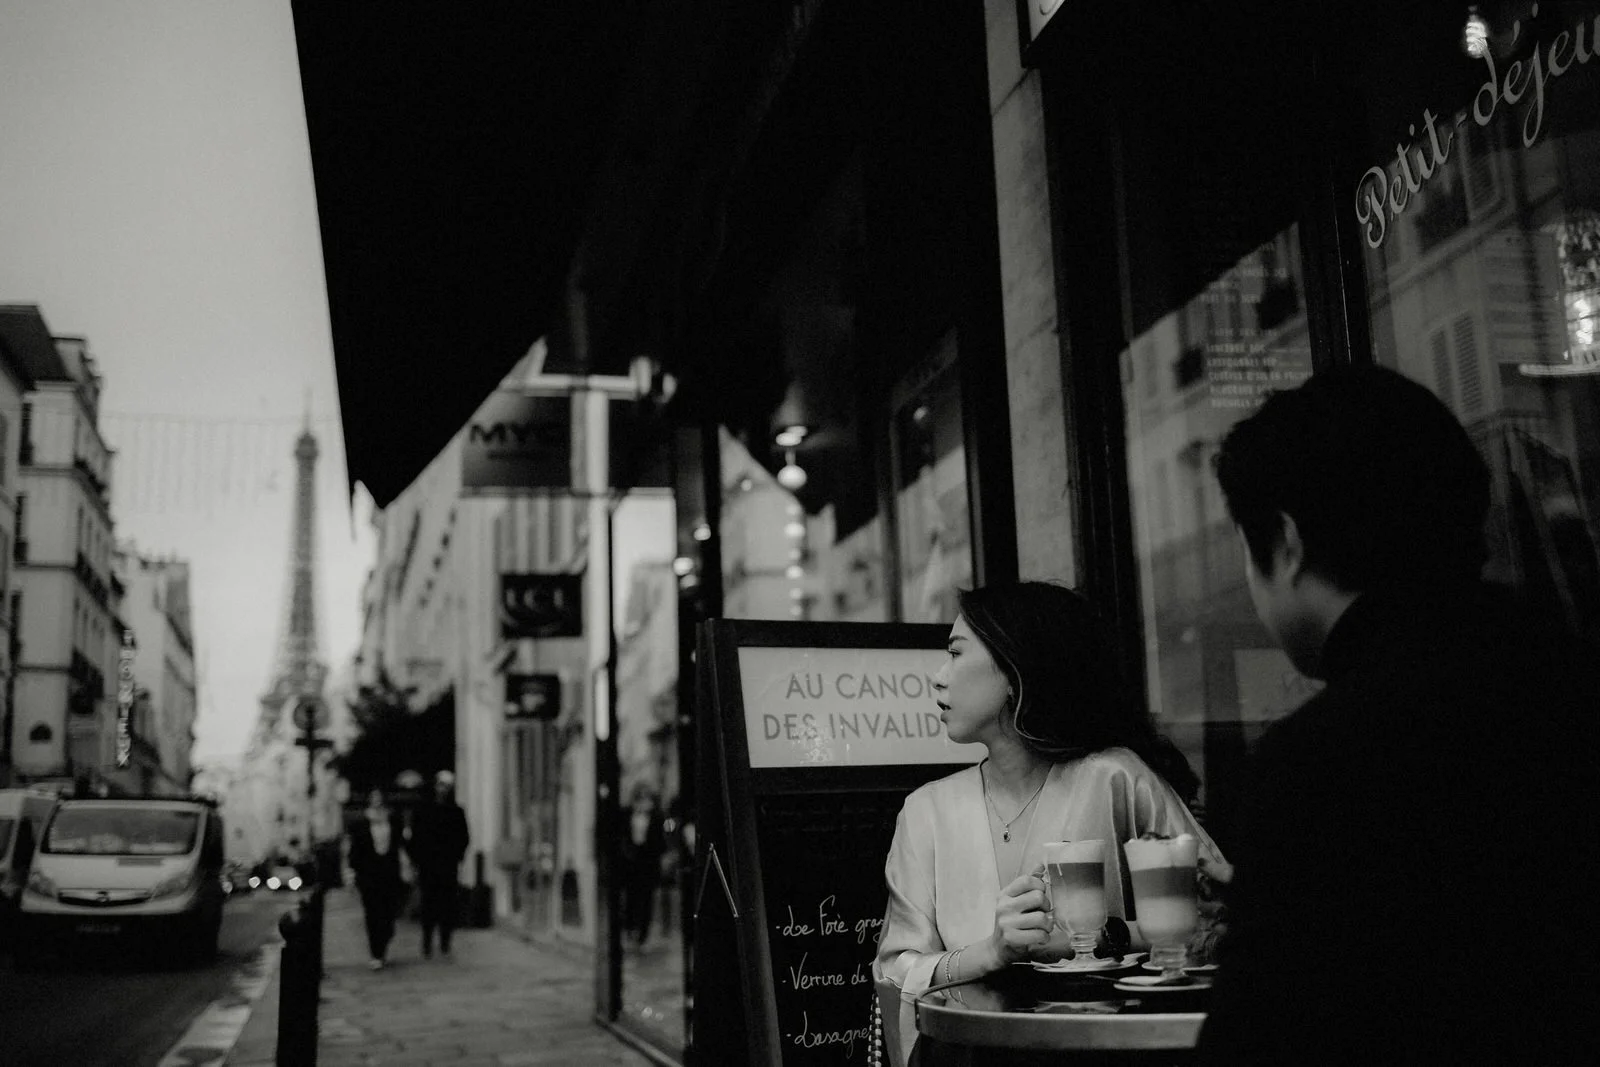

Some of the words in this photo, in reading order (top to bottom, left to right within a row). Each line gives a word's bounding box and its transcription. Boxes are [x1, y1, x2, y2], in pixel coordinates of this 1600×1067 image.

[786, 673, 824, 699] AU
[763, 713, 818, 740] DES
[829, 712, 941, 738] INVALID
[782, 905, 815, 937] Le
[819, 894, 849, 936] Foie
[790, 951, 846, 990] Verrine
[851, 963, 868, 985] de
